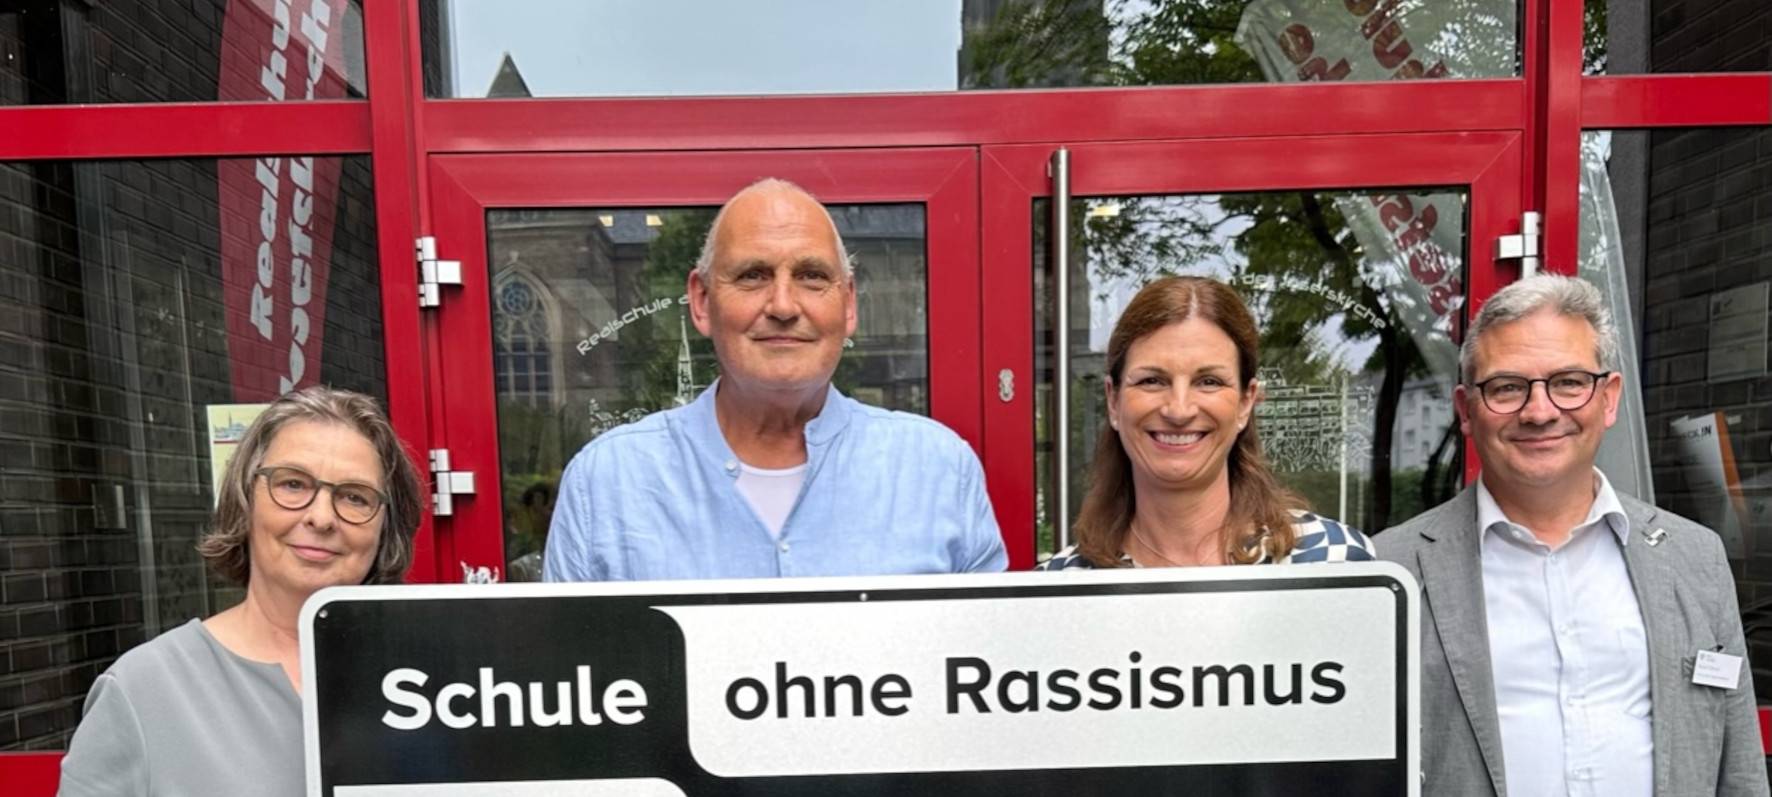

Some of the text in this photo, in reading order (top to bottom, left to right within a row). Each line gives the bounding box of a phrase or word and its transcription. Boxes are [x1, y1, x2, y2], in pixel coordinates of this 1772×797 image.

[576, 297, 672, 356] Realschule
[381, 651, 1346, 730] Schule ohne Rassismus
